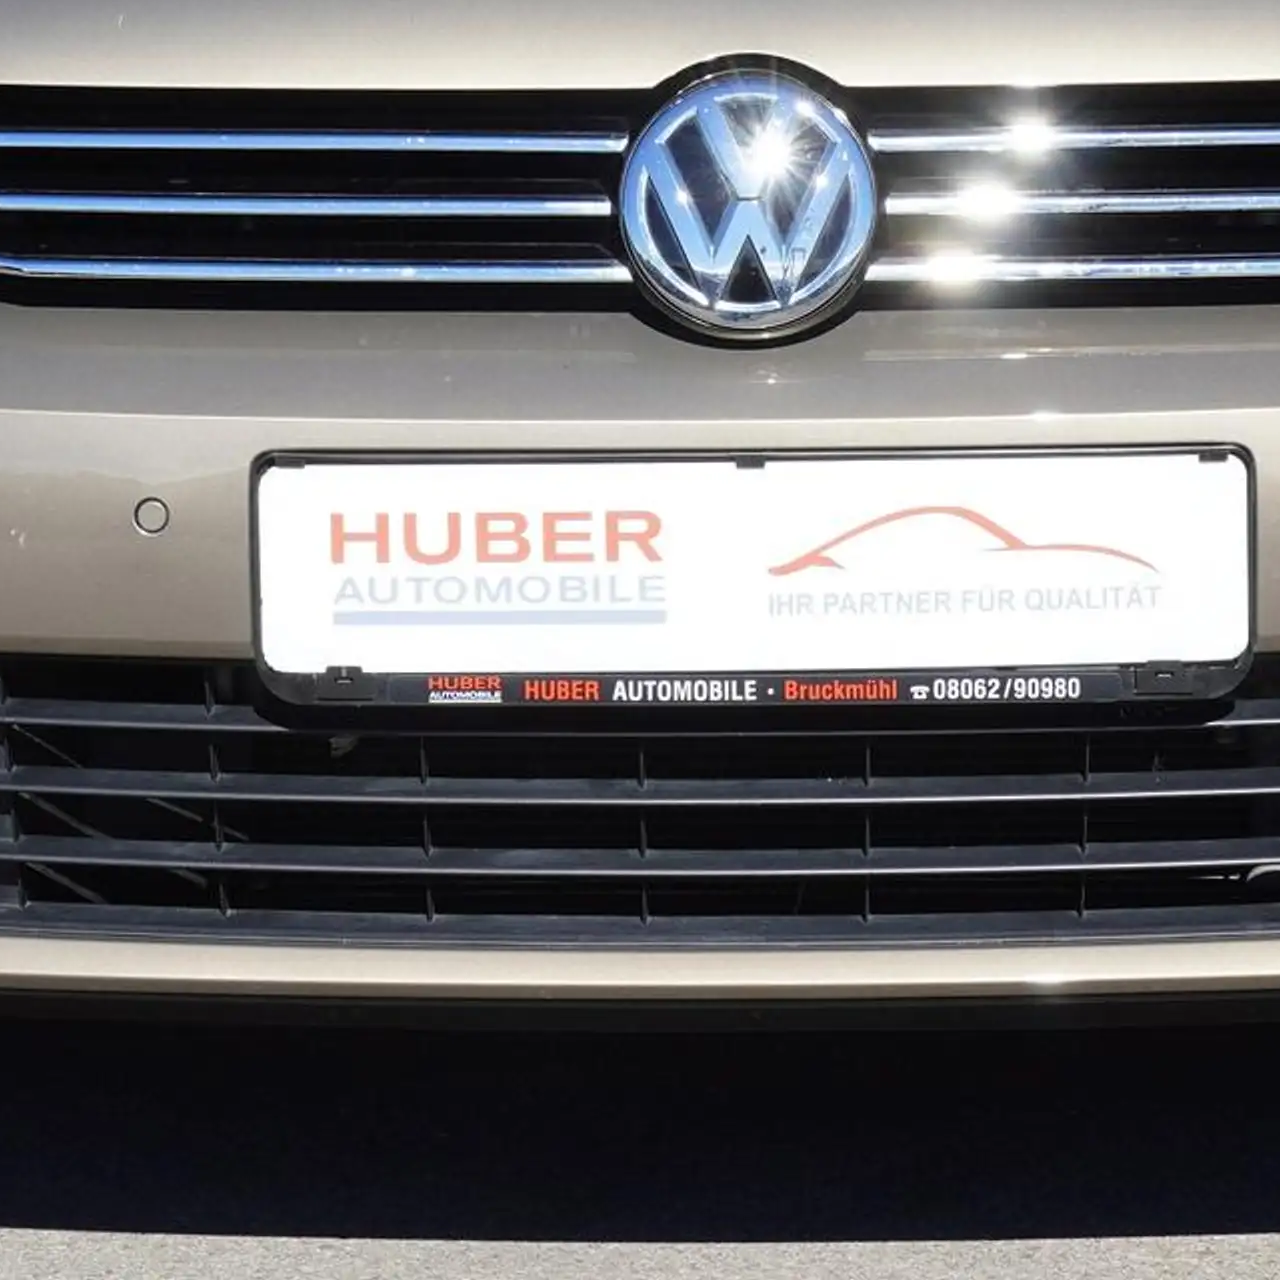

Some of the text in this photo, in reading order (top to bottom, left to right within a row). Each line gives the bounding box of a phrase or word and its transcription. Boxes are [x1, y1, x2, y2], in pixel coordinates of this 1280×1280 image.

[330, 511, 663, 565] HUBER
[333, 575, 666, 606] AUTOMOBILE
[768, 584, 1162, 617] IHR PARTNER FÜR QUALITÄT
[428, 675, 502, 690] HUBER
[428, 690, 502, 700] AUTOMOBILE
[524, 677, 1081, 702] HUBER AUTOMOBILE Bruckmühl 08062/90980
